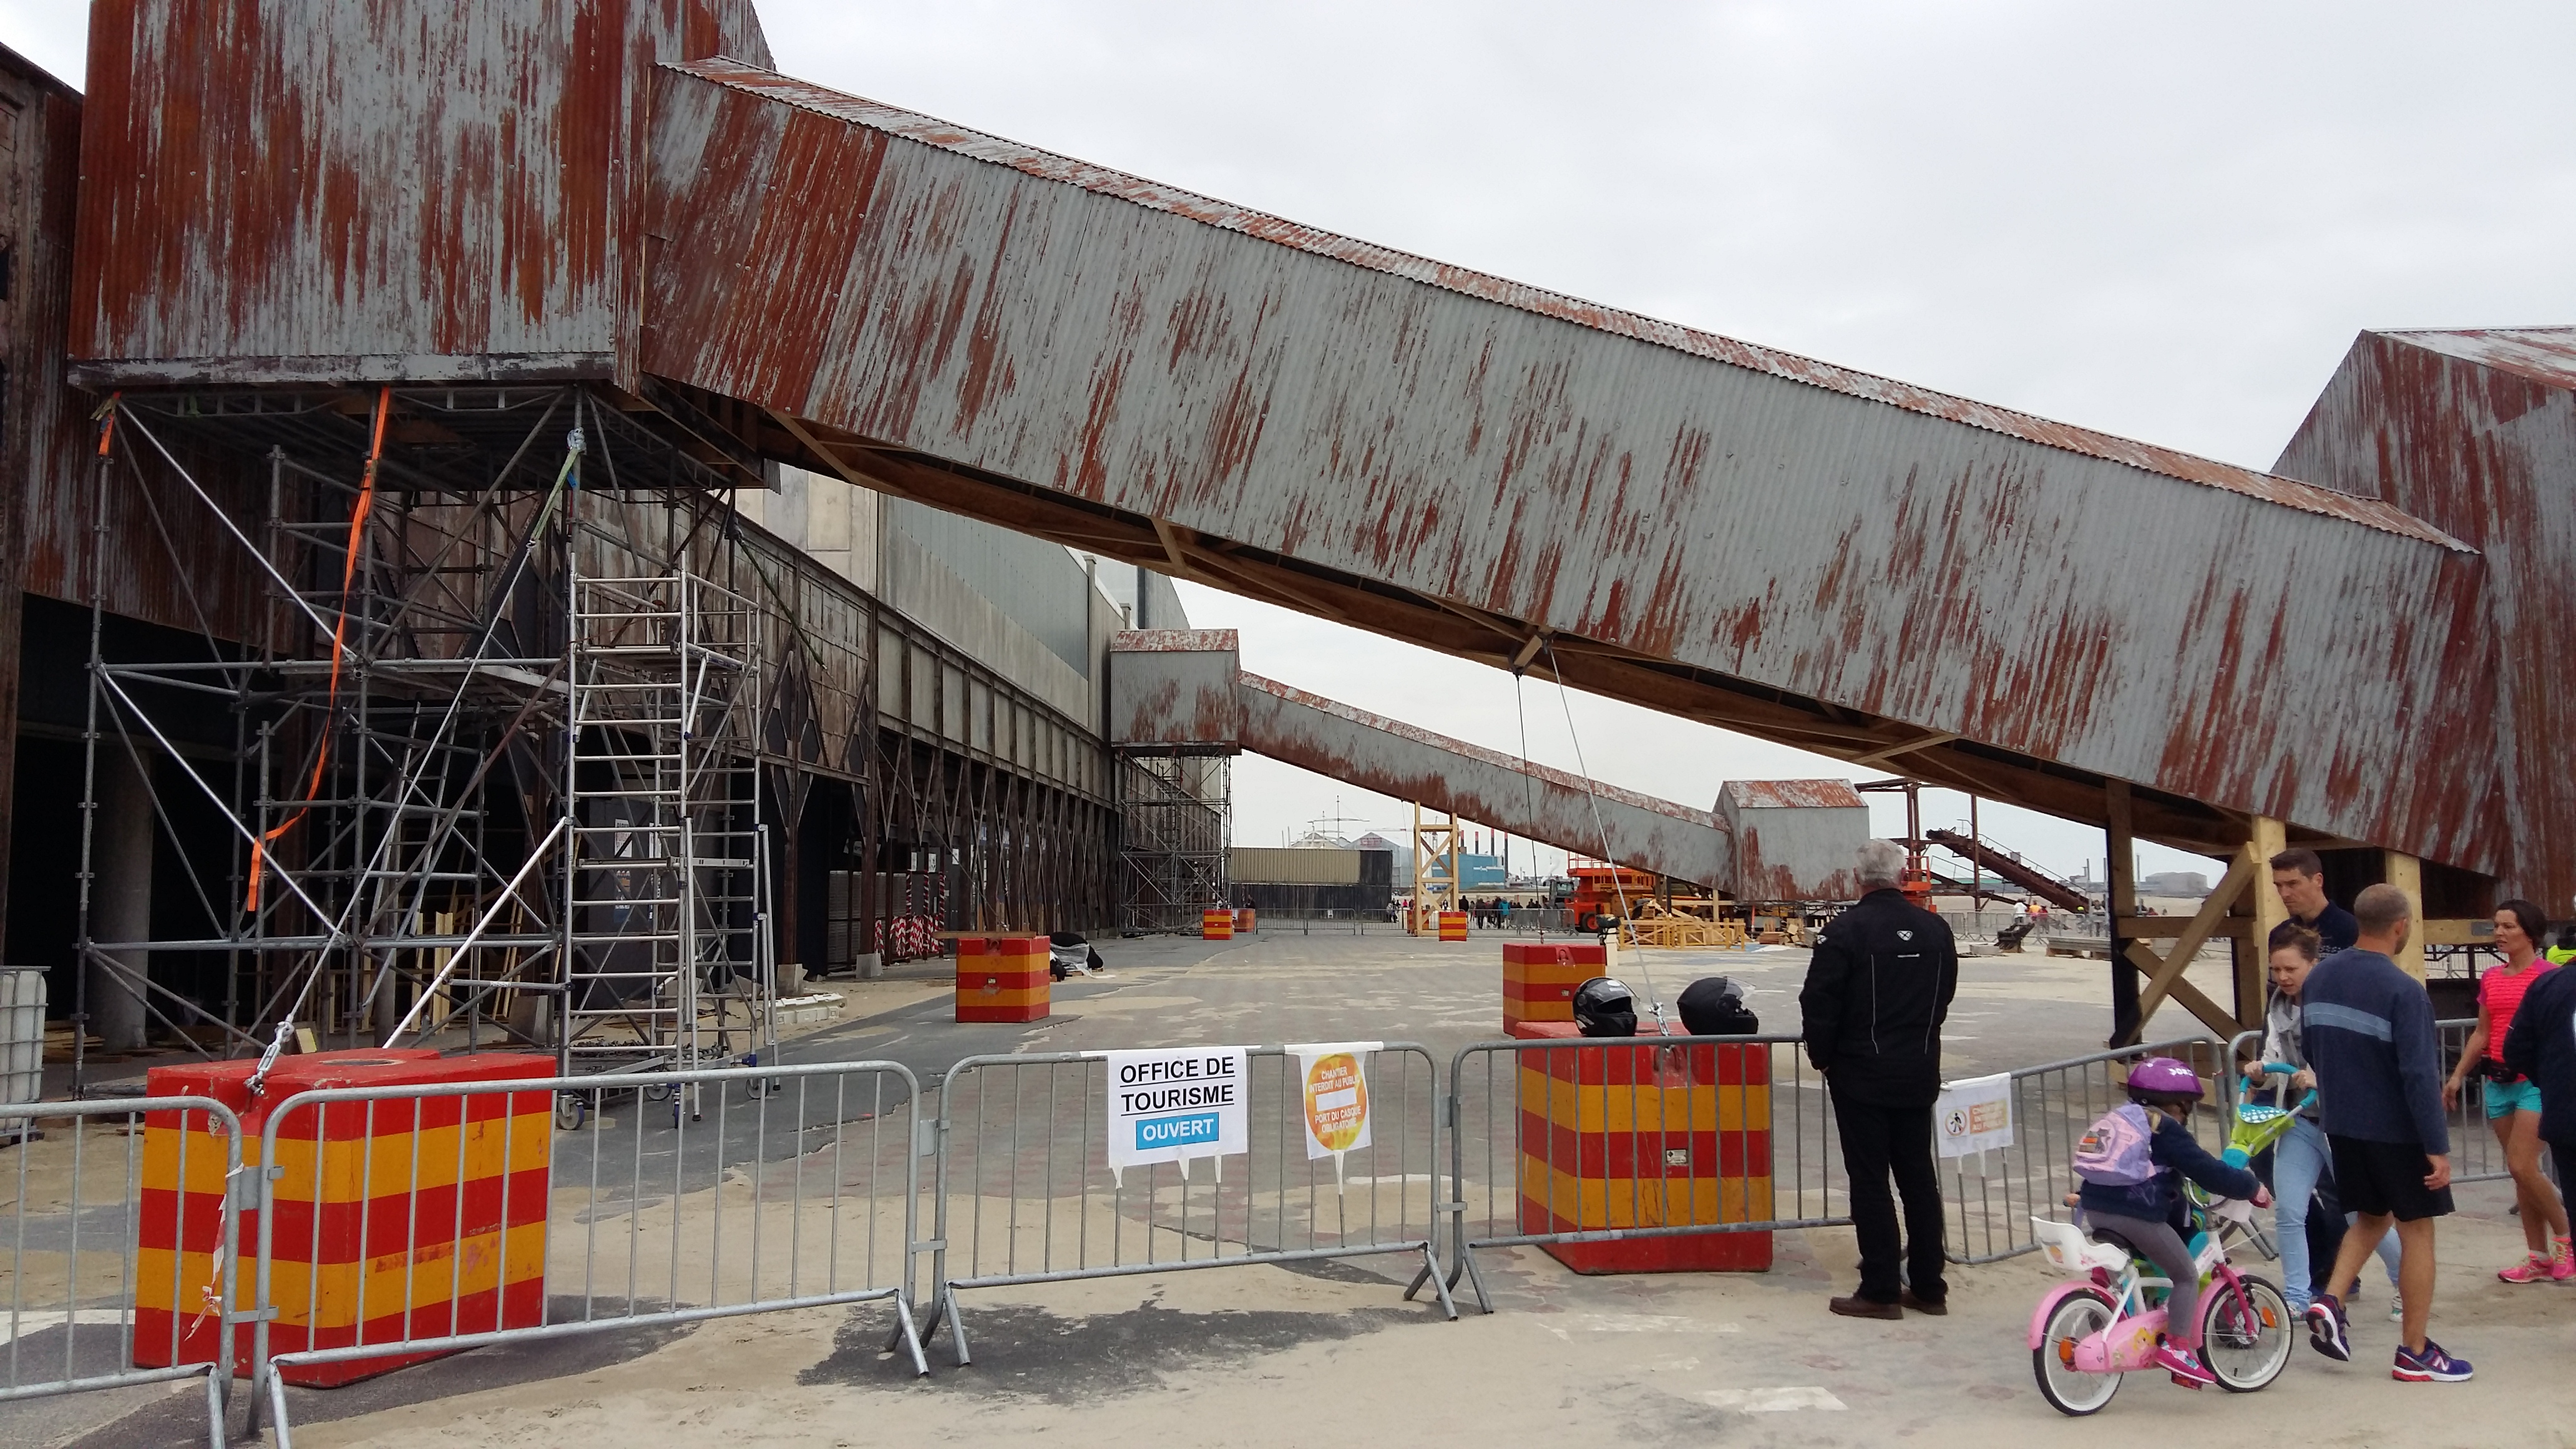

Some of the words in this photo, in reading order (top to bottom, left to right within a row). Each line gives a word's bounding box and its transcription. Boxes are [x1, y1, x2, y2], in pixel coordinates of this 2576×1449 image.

[1120, 1059, 1199, 1083] OFFICE
[1206, 1056, 1234, 1075] DE
[1322, 1066, 1347, 1080] CHANTIER
[1309, 1080, 1334, 1093] INTERDIT
[1335, 1078, 1342, 1088] AU
[1342, 1075, 1360, 1086] PUBLIC
[1121, 1084, 1234, 1112] TOURISME
[1315, 1112, 1330, 1124] PORT
[1331, 1110, 1340, 1121] DU
[1340, 1105, 1361, 1118] CASQUE
[1143, 1118, 1214, 1141] OUVERT
